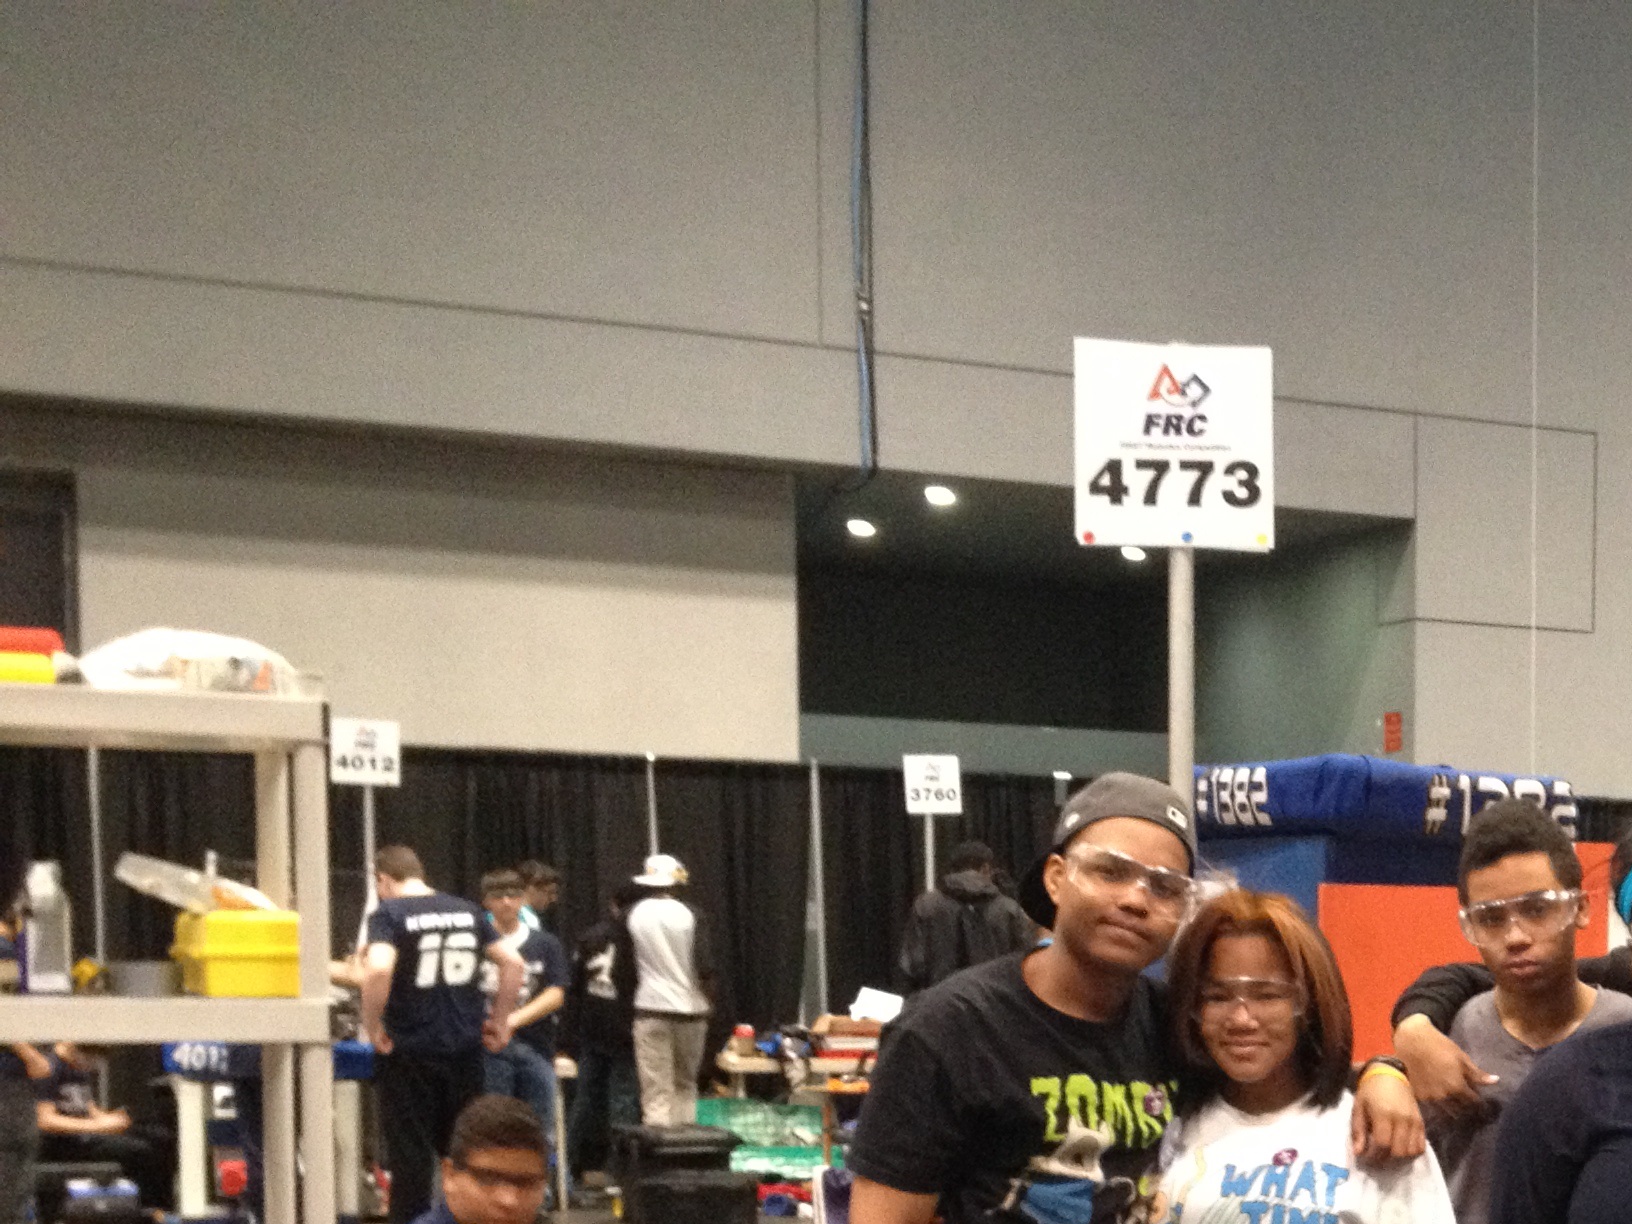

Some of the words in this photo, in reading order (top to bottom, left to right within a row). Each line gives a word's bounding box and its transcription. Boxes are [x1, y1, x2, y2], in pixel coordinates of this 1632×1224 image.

[1142, 412, 1208, 437] FRC
[1089, 459, 1261, 507] 4773
[335, 754, 395, 772] 4012
[910, 787, 957, 802] 3760
[1221, 1160, 1350, 1207] WHAT
